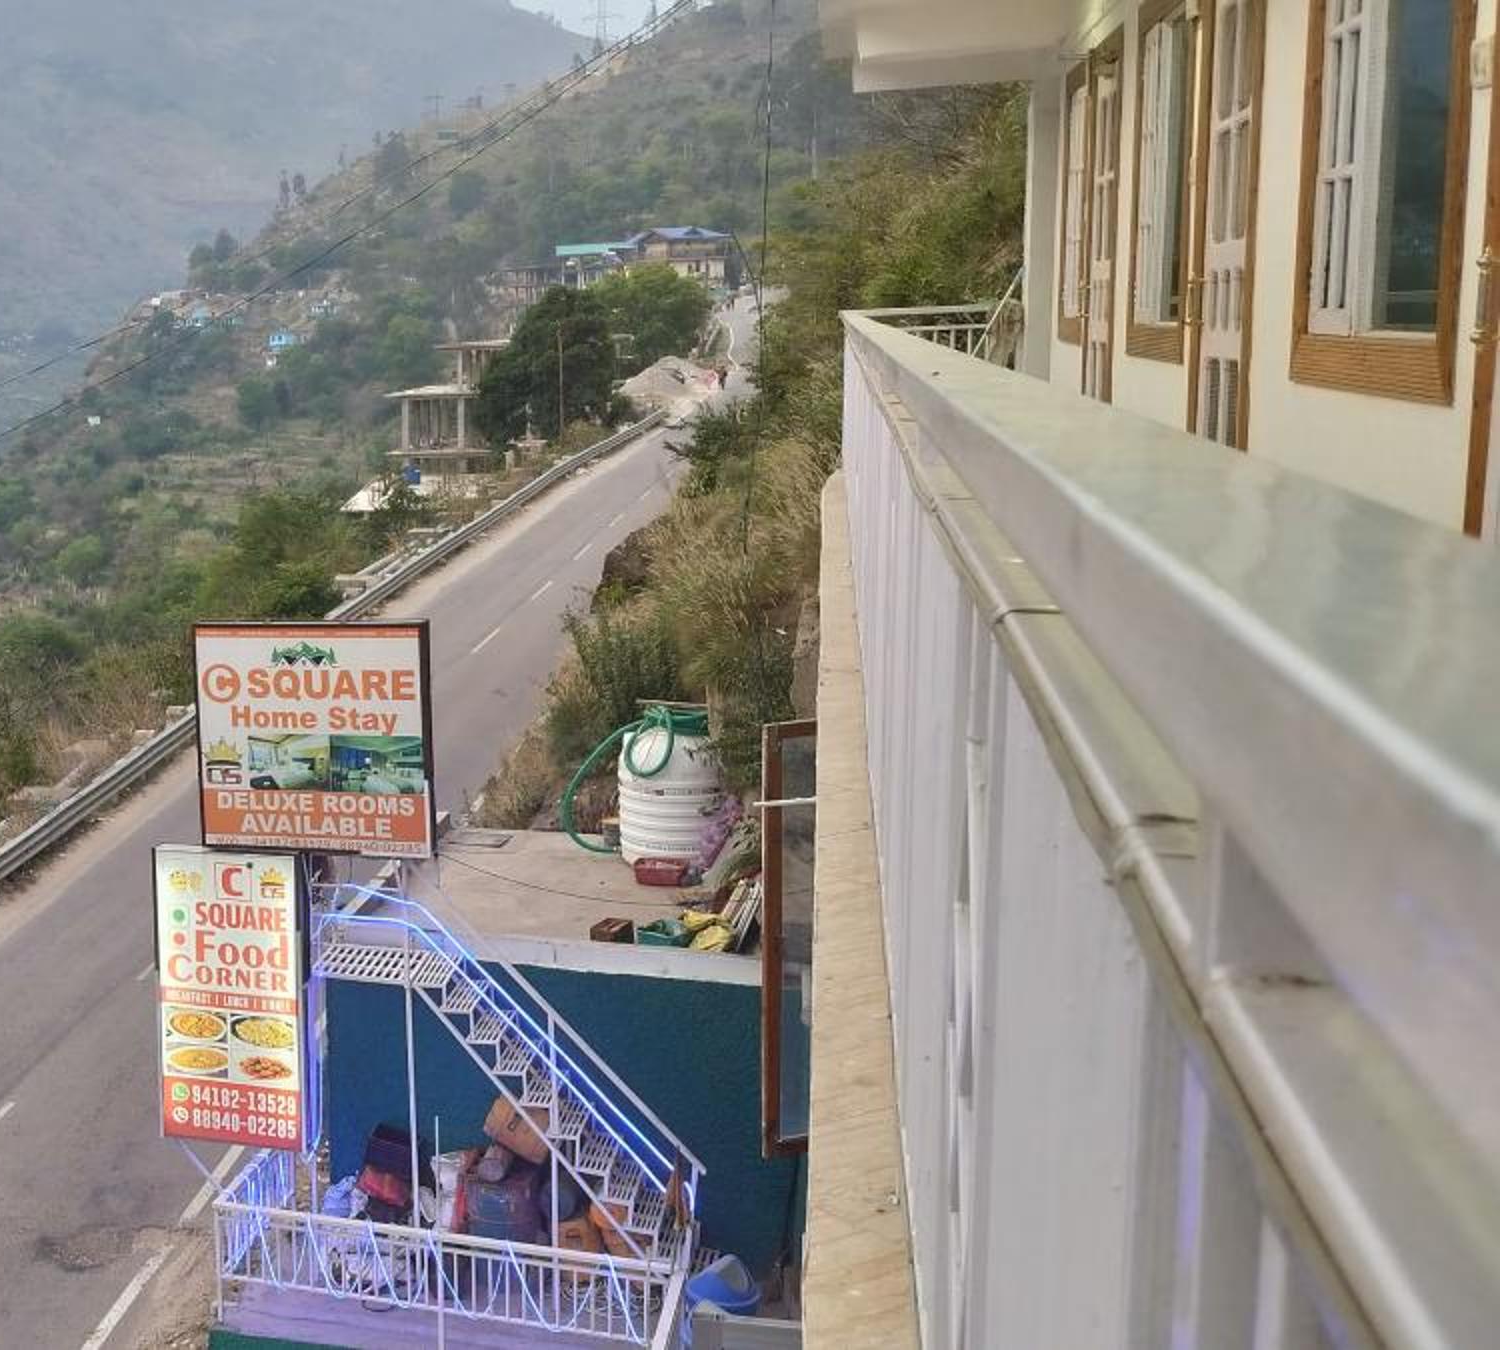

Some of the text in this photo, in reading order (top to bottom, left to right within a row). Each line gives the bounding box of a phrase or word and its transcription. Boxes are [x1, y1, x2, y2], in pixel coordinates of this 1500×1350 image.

[247, 668, 416, 701] SQUARE
[231, 706, 398, 735] Home Stay
[217, 791, 415, 816] DELUXE ROOMS
[240, 812, 392, 838] AVAILABLE
[221, 866, 243, 896] C
[195, 901, 287, 932] SQUARE
[195, 930, 289, 970] Food
